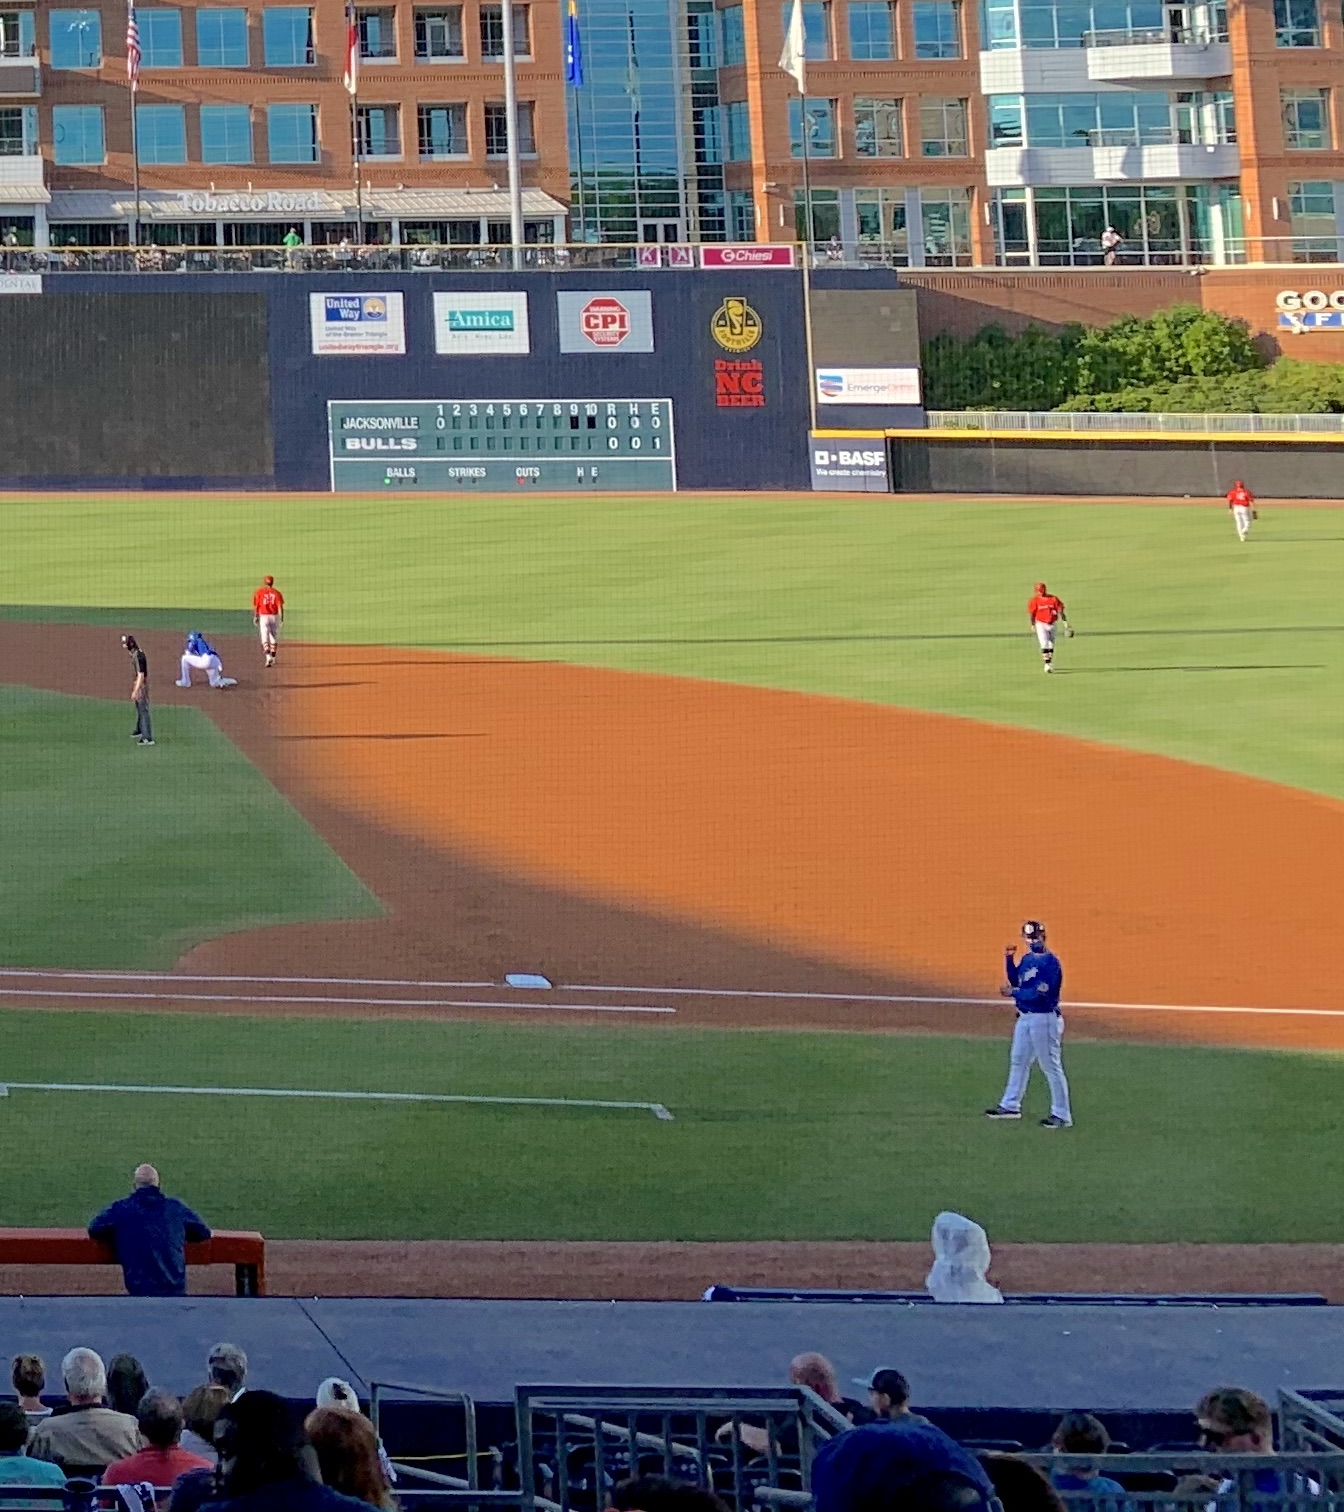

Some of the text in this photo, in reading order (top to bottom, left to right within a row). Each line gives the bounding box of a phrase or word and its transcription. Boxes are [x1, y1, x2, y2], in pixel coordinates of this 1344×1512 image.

[177, 190, 321, 212] Tobacco Road
[641, 247, 654, 261] K
[734, 250, 773, 262] Chiesi
[326, 298, 360, 308] United
[339, 308, 360, 320] Way
[451, 310, 511, 327] Amica
[1315, 313, 1344, 326] F
[584, 314, 627, 329] CPI
[714, 359, 763, 370] Drink
[715, 372, 764, 394] NC
[716, 394, 766, 407] BEER
[436, 403, 660, 416] 1 2 3 4 5 6 7 8 9 10 R H E
[342, 416, 661, 429] JACKSONVILLE 0 0 0 0
[345, 437, 661, 450] BULLS 0 0 1
[838, 450, 885, 465] BASF
[386, 467, 599, 477] BALLS STRIKES OUTS H E
[816, 468, 887, 478] We create chemistry
